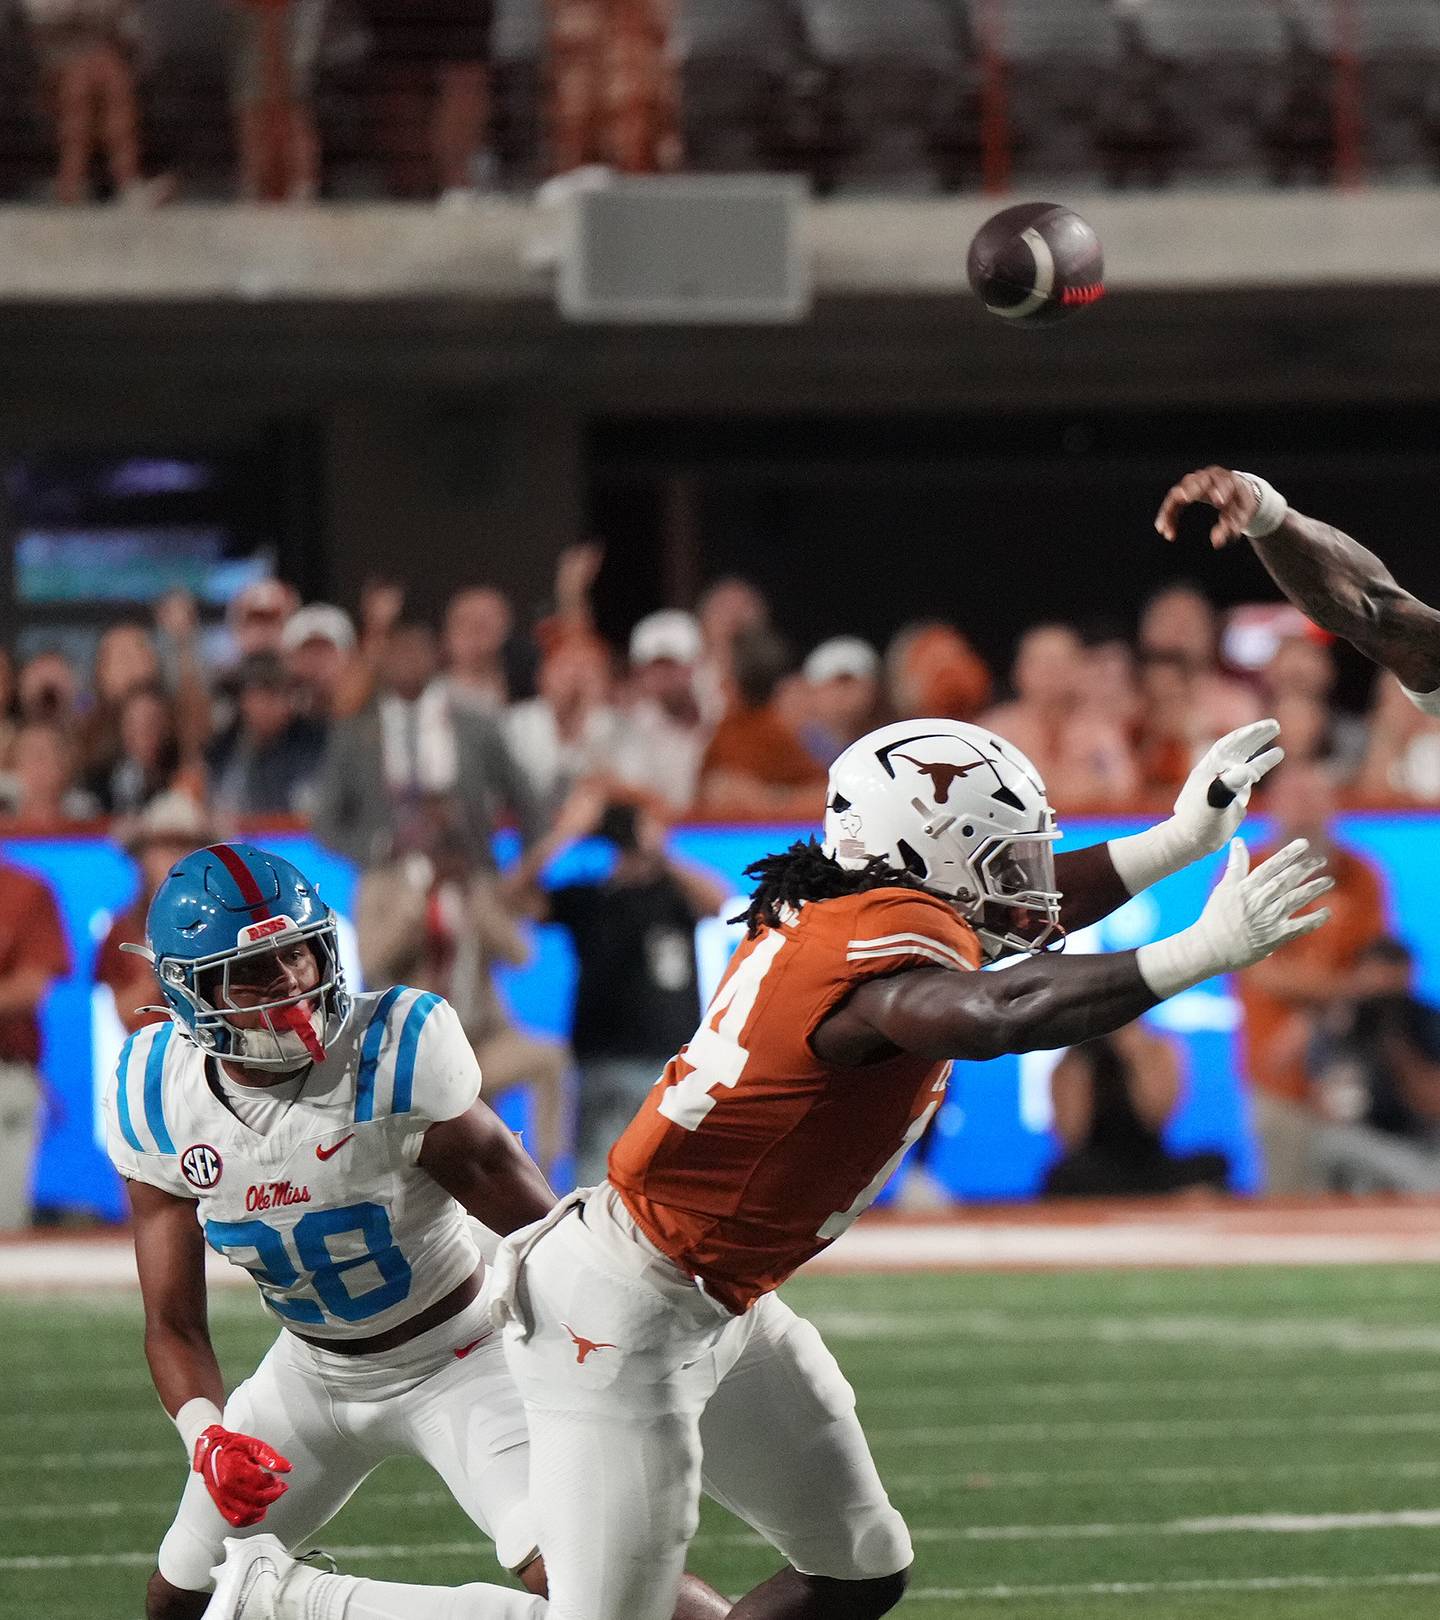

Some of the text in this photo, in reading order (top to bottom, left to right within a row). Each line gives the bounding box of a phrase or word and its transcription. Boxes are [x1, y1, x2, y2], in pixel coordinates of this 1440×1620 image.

[247, 918, 287, 941] REBS
[655, 928, 787, 1132] 4
[182, 1147, 221, 1186] SEC
[246, 1181, 311, 1211] Ole Miss
[204, 1201, 412, 1326] 28
